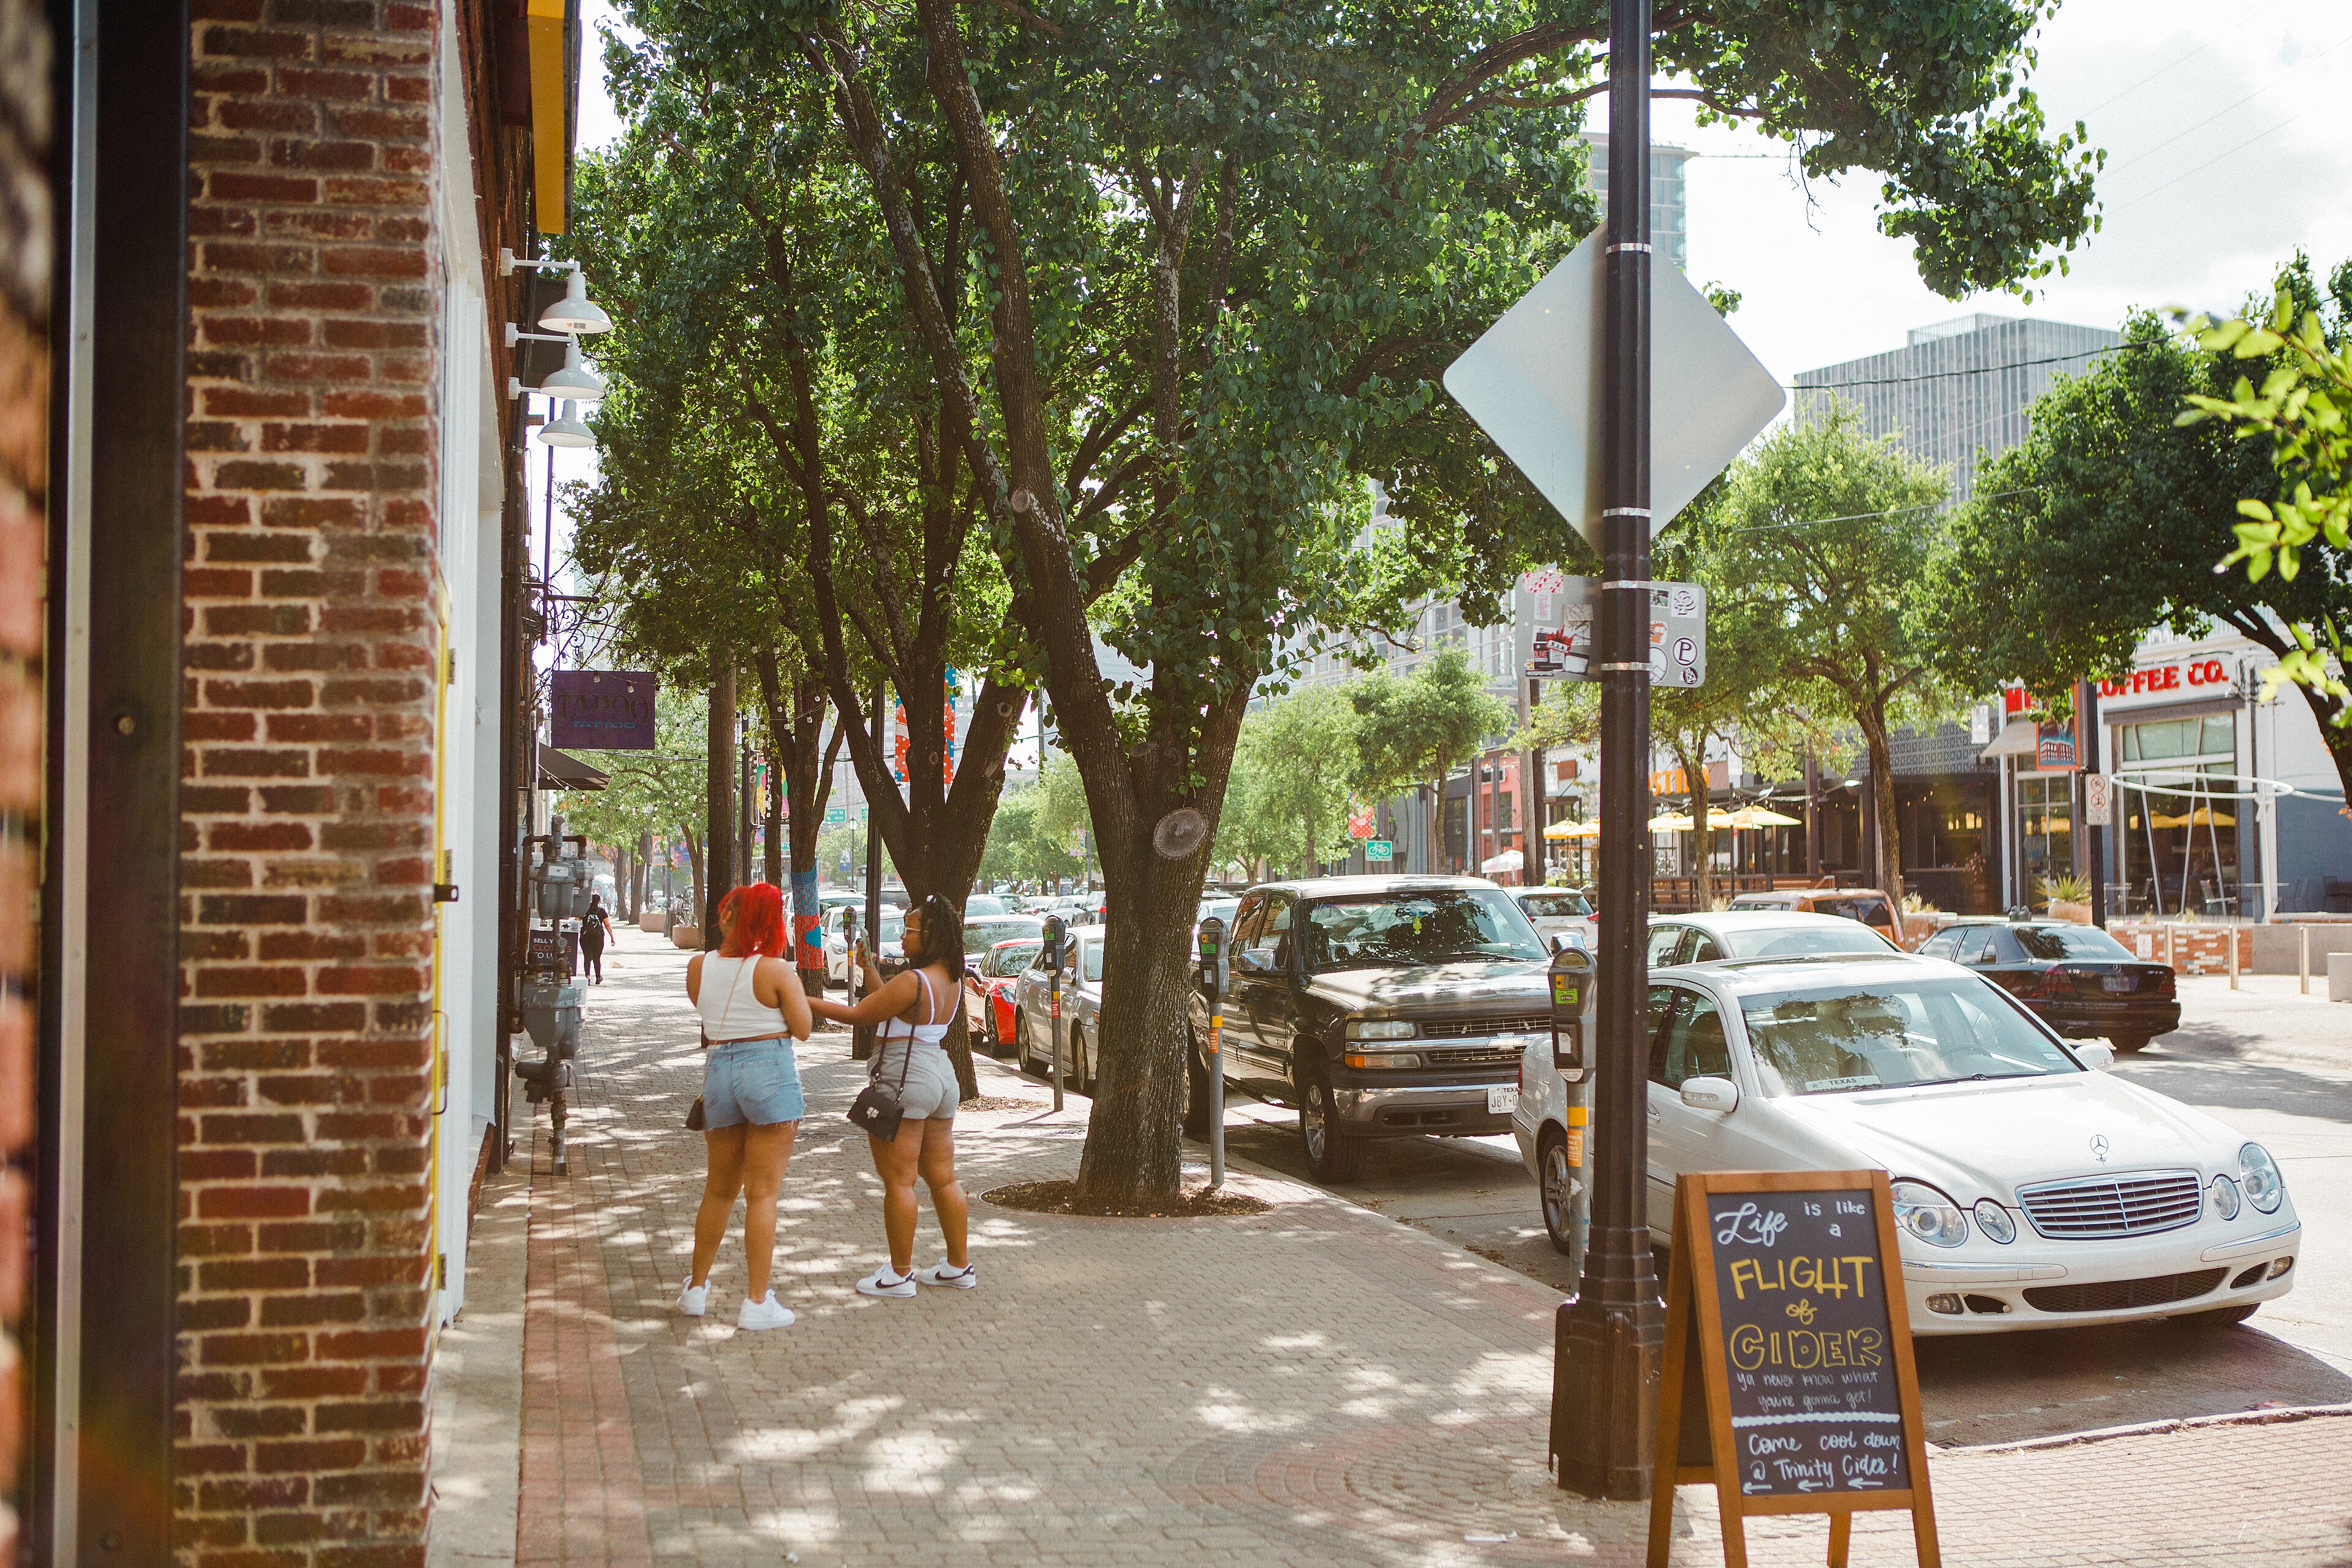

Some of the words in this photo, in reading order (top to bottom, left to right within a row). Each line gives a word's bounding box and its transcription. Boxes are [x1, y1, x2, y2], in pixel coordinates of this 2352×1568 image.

[2097, 665, 2180, 698] OFFEE
[2188, 660, 2230, 685] CO.
[557, 694, 649, 725] TABOO
[533, 944, 572, 952] CLOS
[1491, 1095, 1507, 1107] JBY
[1715, 1202, 1789, 1247] Life
[1804, 1201, 1822, 1216] is
[1837, 1200, 1866, 1216] like
[1830, 1223, 1841, 1237] a
[1730, 1256, 1874, 1300] FLIGHT
[1785, 1298, 1818, 1325] of
[1730, 1324, 1883, 1370] CIDER
[1736, 1372, 1755, 1392] ya
[1763, 1373, 1795, 1387] never
[1802, 1373, 1834, 1387] know
[1842, 1371, 1878, 1383] what
[1803, 1393, 1840, 1412] gonna
[1847, 1389, 1871, 1409] get!
[1749, 1433, 1802, 1455] Come
[1820, 1430, 1857, 1450] cool
[1864, 1431, 1900, 1450] down
[1751, 1460, 1765, 1480] @
[1773, 1458, 1834, 1488] Trinity
